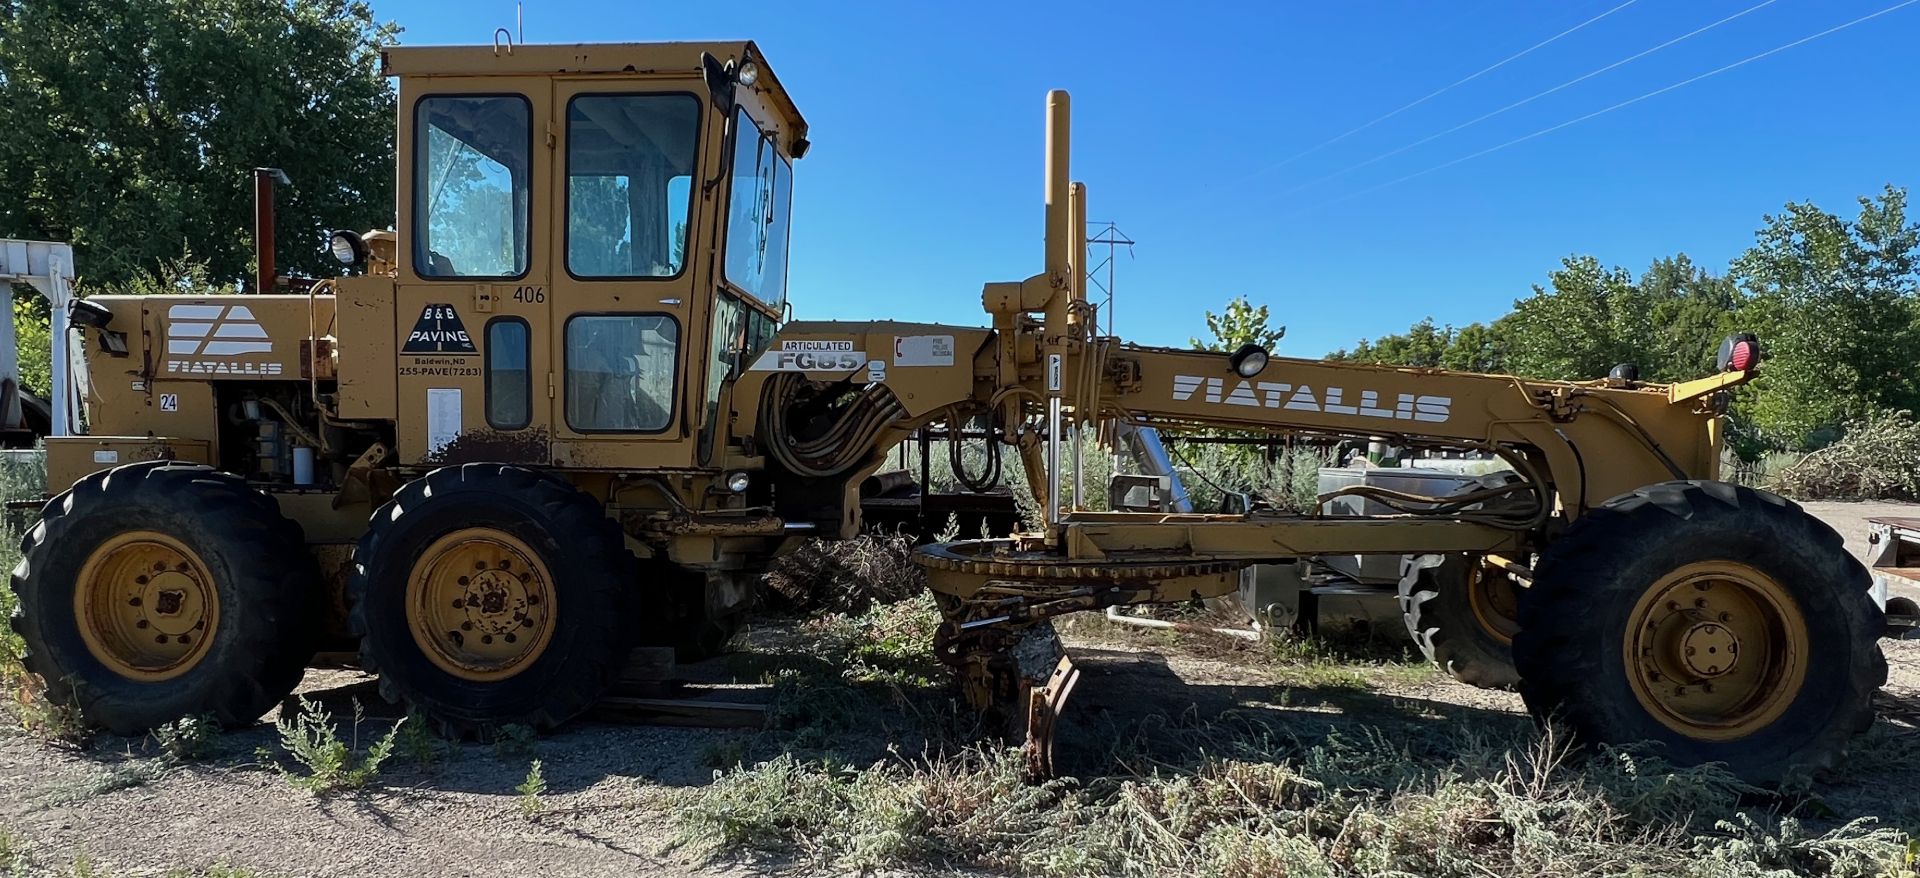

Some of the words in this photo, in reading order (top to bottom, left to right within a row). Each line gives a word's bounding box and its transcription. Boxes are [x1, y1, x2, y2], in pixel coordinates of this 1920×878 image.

[513, 286, 545, 304] 406
[424, 308, 432, 319] B
[435, 308, 443, 319] &
[446, 308, 454, 319] B
[408, 330, 471, 342] PAVING
[784, 341, 851, 351] ARTICULATED
[167, 360, 282, 375] FIATALLIS
[414, 357, 466, 367] Baldwin,ND
[777, 352, 858, 370] FG85
[399, 367, 482, 377] 255-PAVE(7283)
[161, 395, 177, 410] 24
[1172, 375, 1452, 423] FIATALLIS
